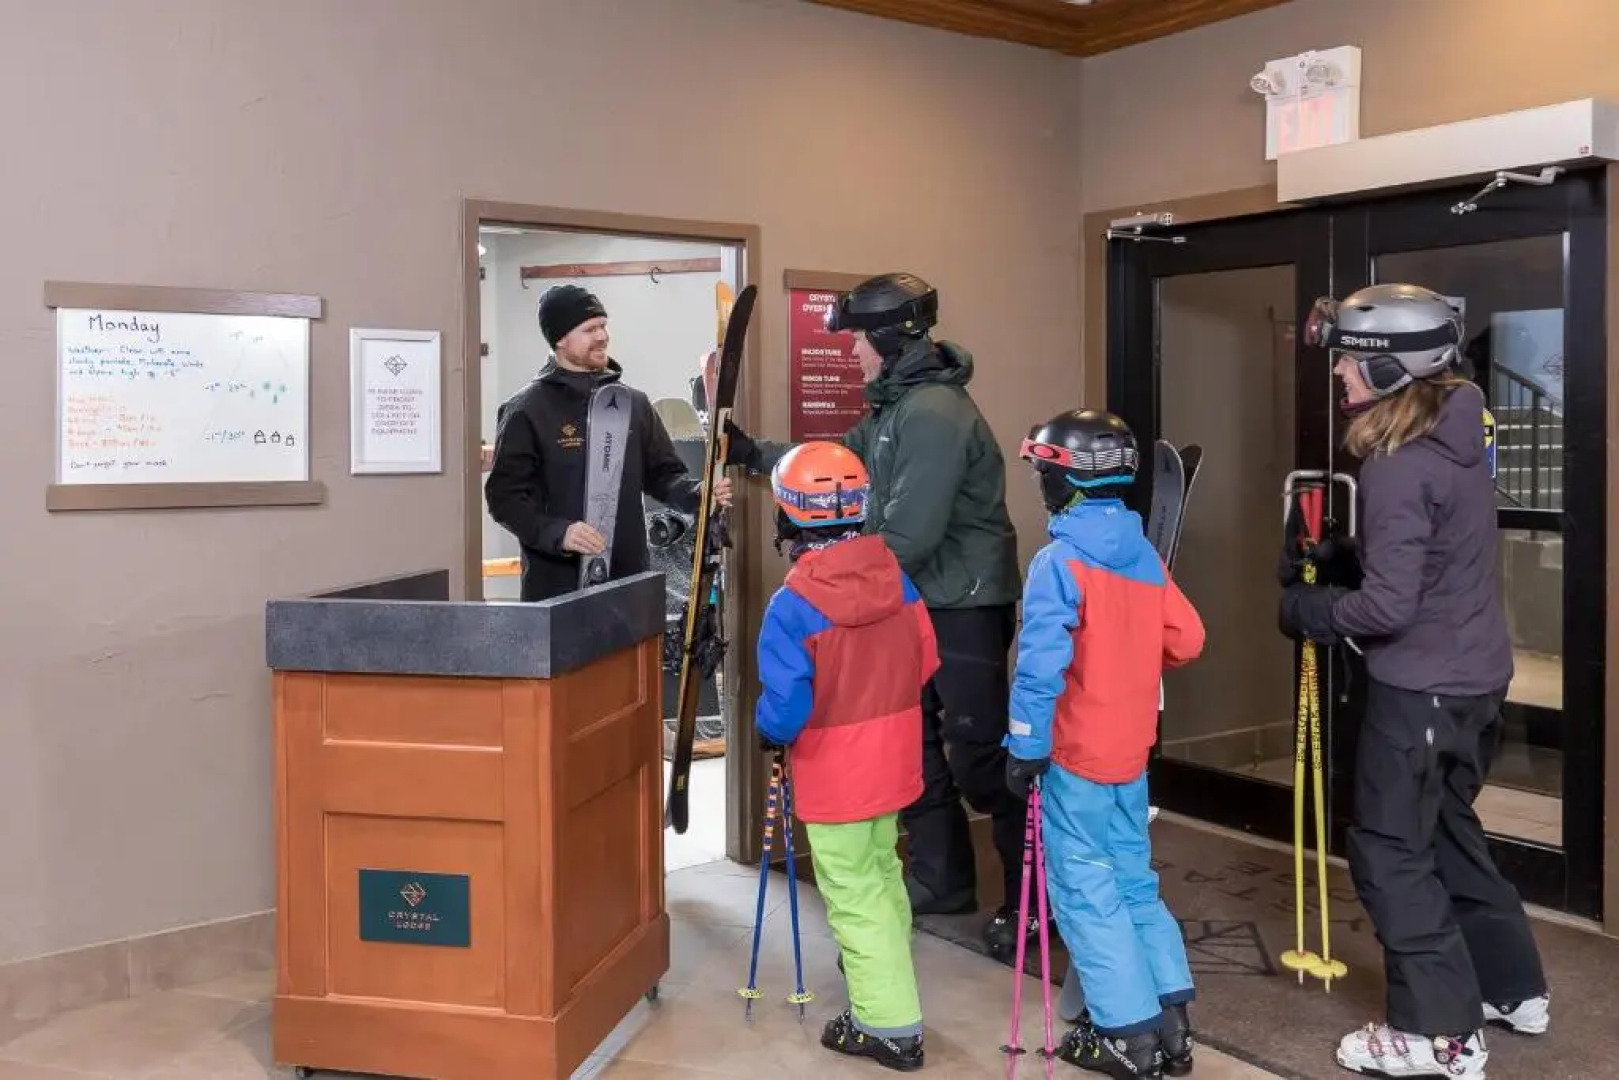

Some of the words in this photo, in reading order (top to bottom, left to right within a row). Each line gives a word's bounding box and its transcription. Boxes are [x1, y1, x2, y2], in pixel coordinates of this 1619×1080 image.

[88, 313, 161, 343] Monday
[1340, 335, 1391, 348] SMITH
[602, 432, 612, 472] ATOMIC
[388, 910, 441, 921] CRYSTAL
[396, 921, 432, 931] LODGE
